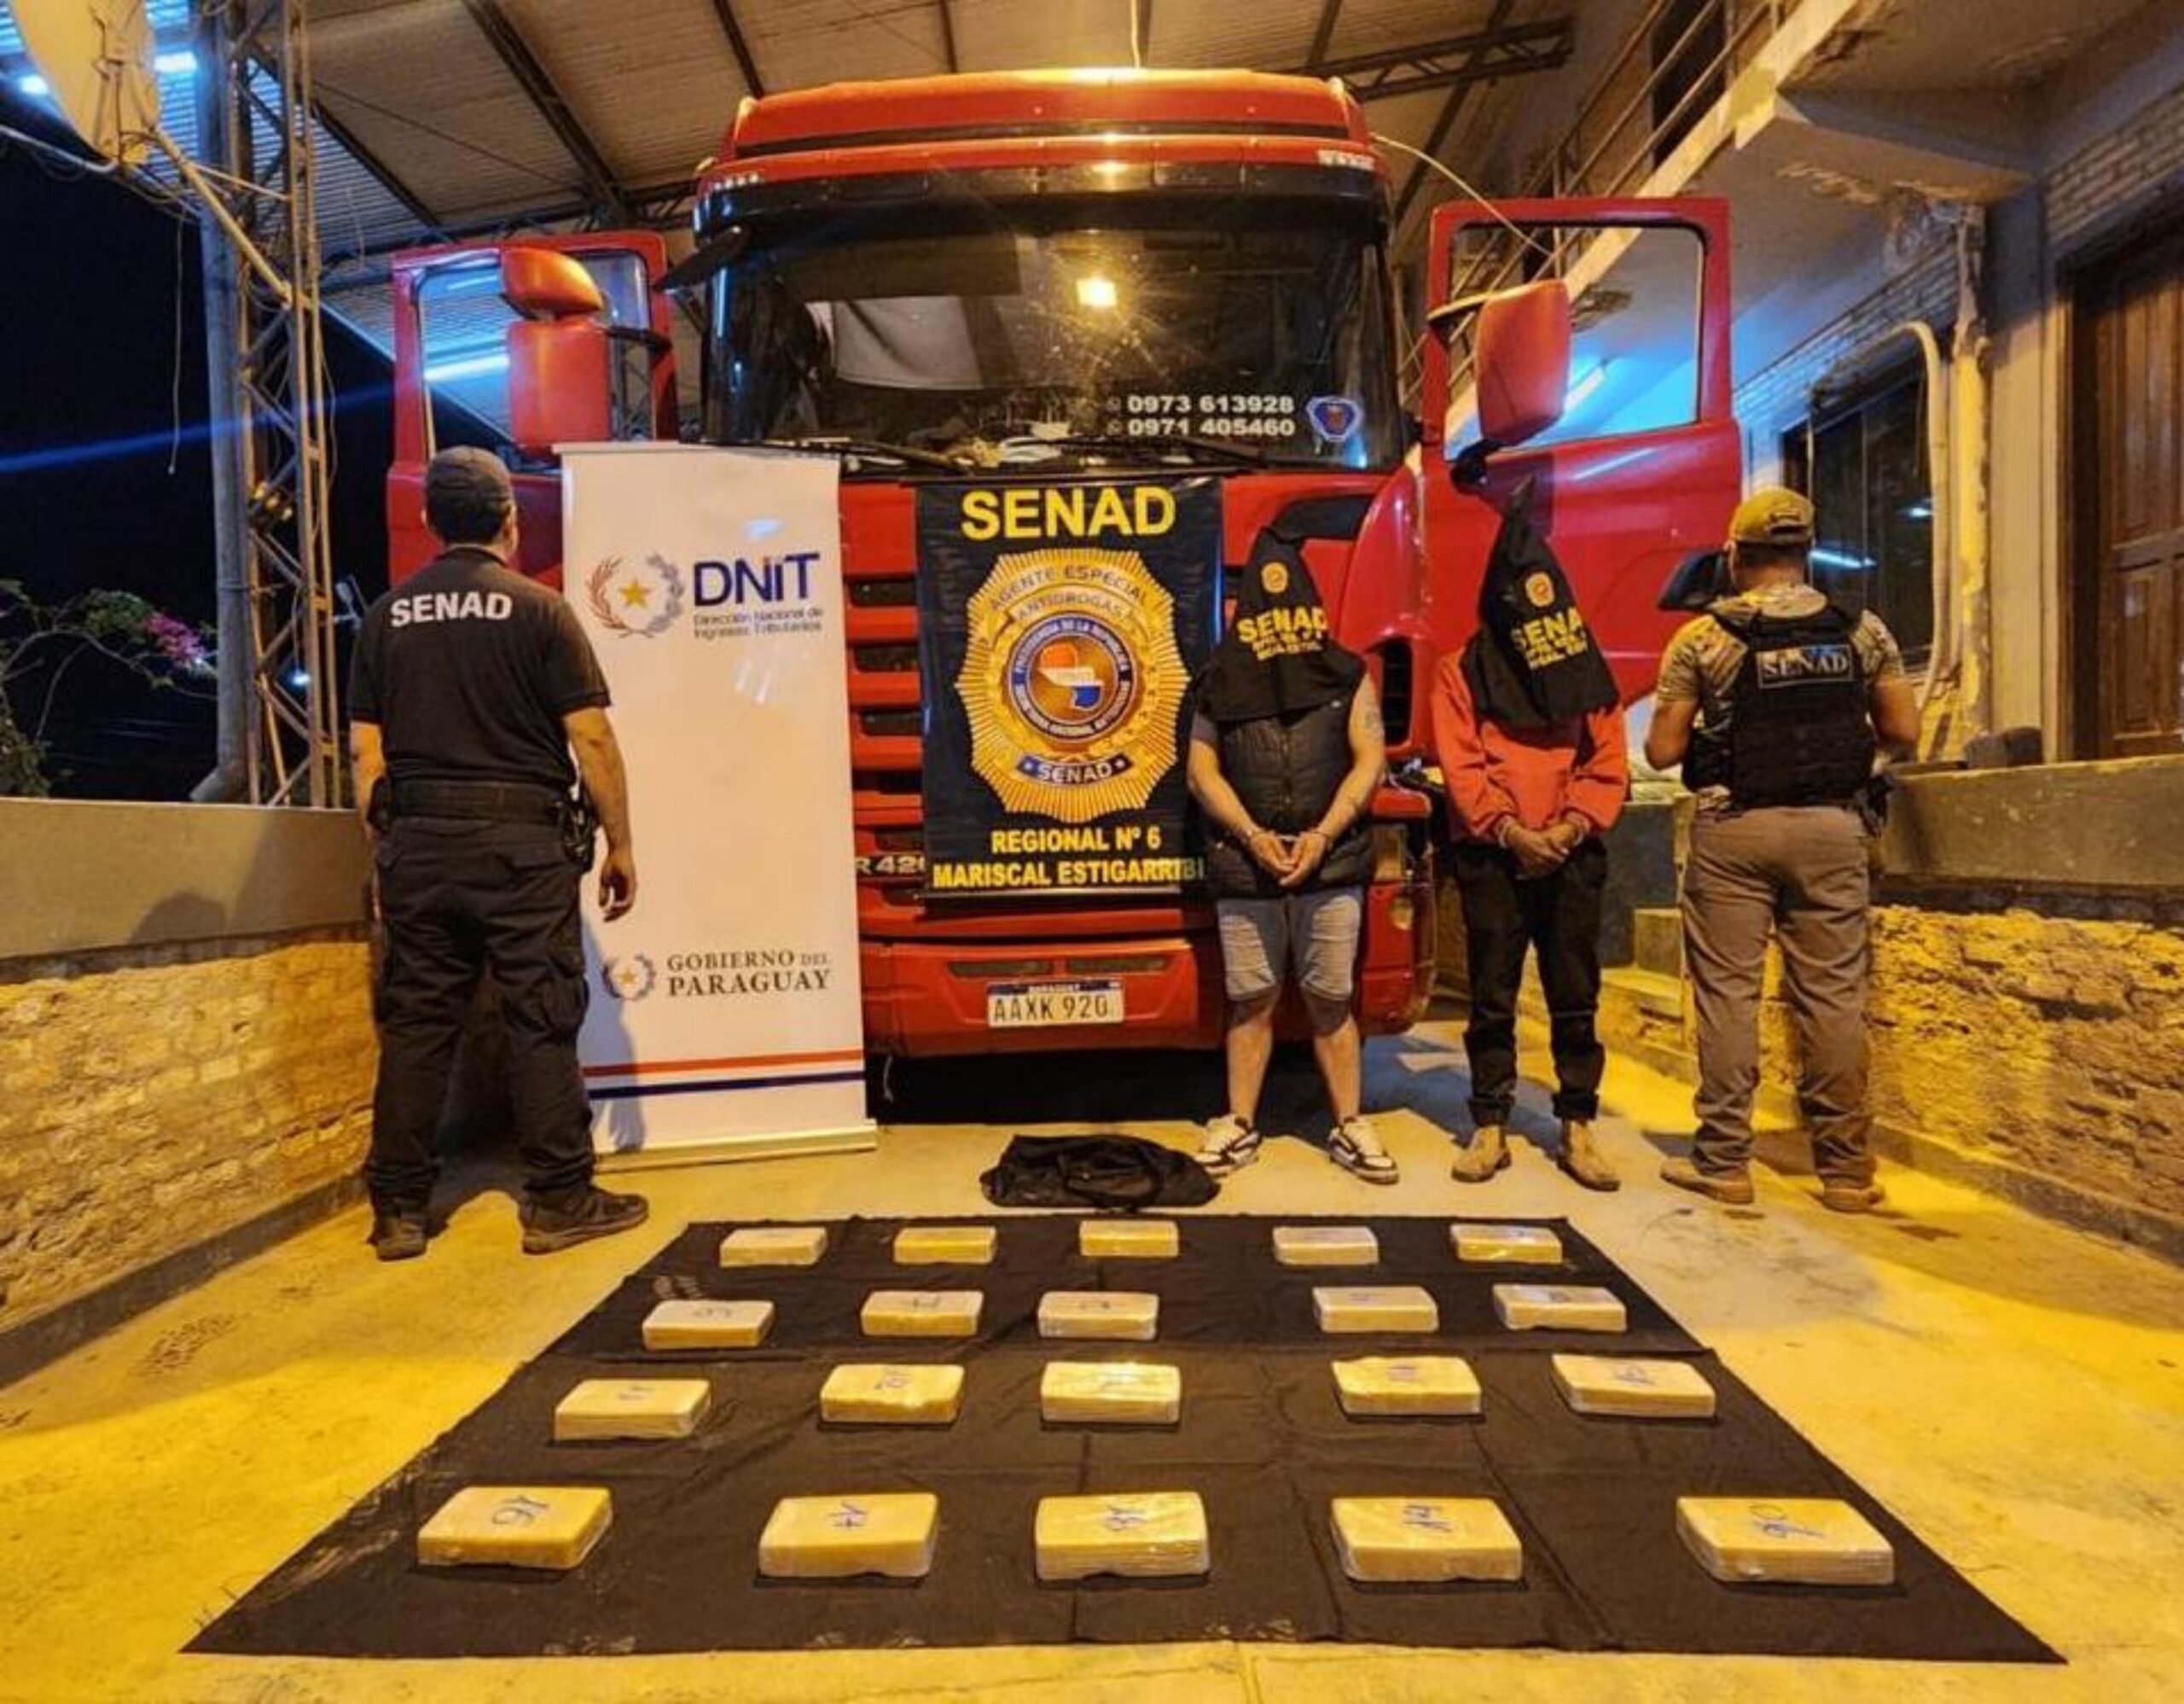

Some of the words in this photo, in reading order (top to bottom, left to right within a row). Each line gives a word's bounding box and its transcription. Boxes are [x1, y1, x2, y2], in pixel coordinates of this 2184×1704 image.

[1127, 395, 1192, 413] 0973
[1199, 395, 1294, 413] 613928
[1127, 418, 1190, 436] 0971
[1199, 418, 1295, 436] 405460
[961, 486, 1176, 540] SENAD
[1063, 564, 1147, 607] ESPECIAL
[390, 591, 512, 627] SENAD
[1510, 607, 1584, 652] SENA
[1763, 654, 1849, 678] SENAD
[1038, 761, 1112, 783] SENAD
[991, 828, 1108, 853] REGIONAL
[1147, 826, 1161, 850] 6
[933, 863, 1051, 888] MARISCAL
[1057, 858, 1203, 885] ESTIGARRIBI
[666, 949, 794, 973] GOBIERNO
[668, 969, 830, 997] PARAGUAY
[995, 995, 1053, 1021] AAXK
[1063, 994, 1107, 1020] 920
